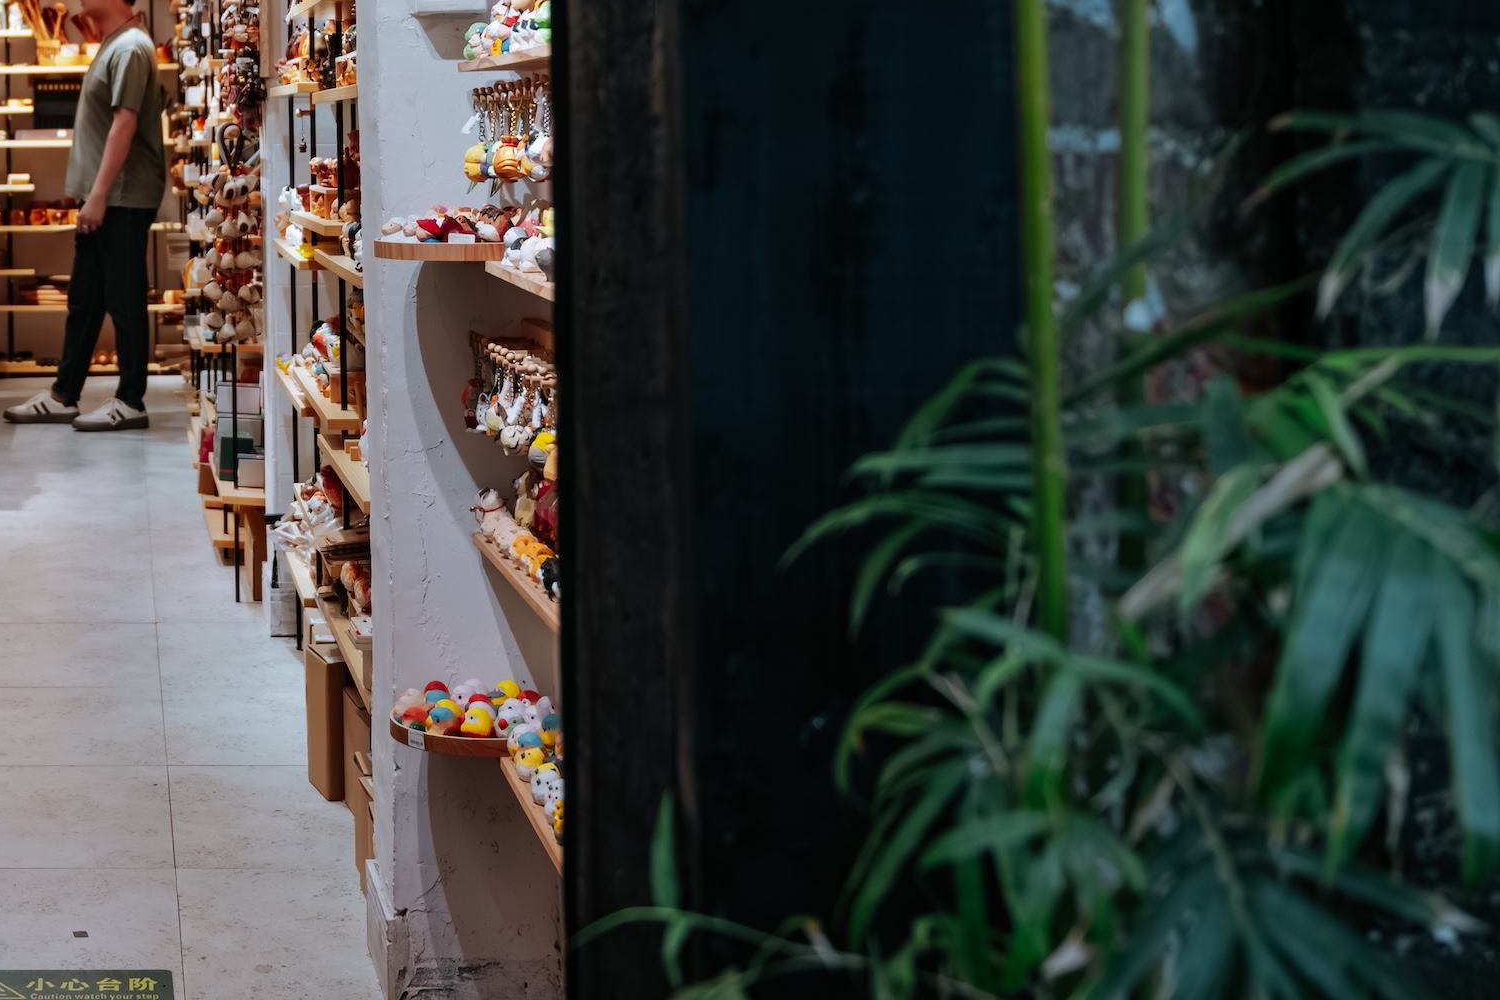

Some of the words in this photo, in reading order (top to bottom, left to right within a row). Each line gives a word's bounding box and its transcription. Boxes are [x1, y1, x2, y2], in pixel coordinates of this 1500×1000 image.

[25, 977, 159, 992] 小心台阶
[30, 992, 72, 1000] Caution
[74, 992, 107, 1000] watch
